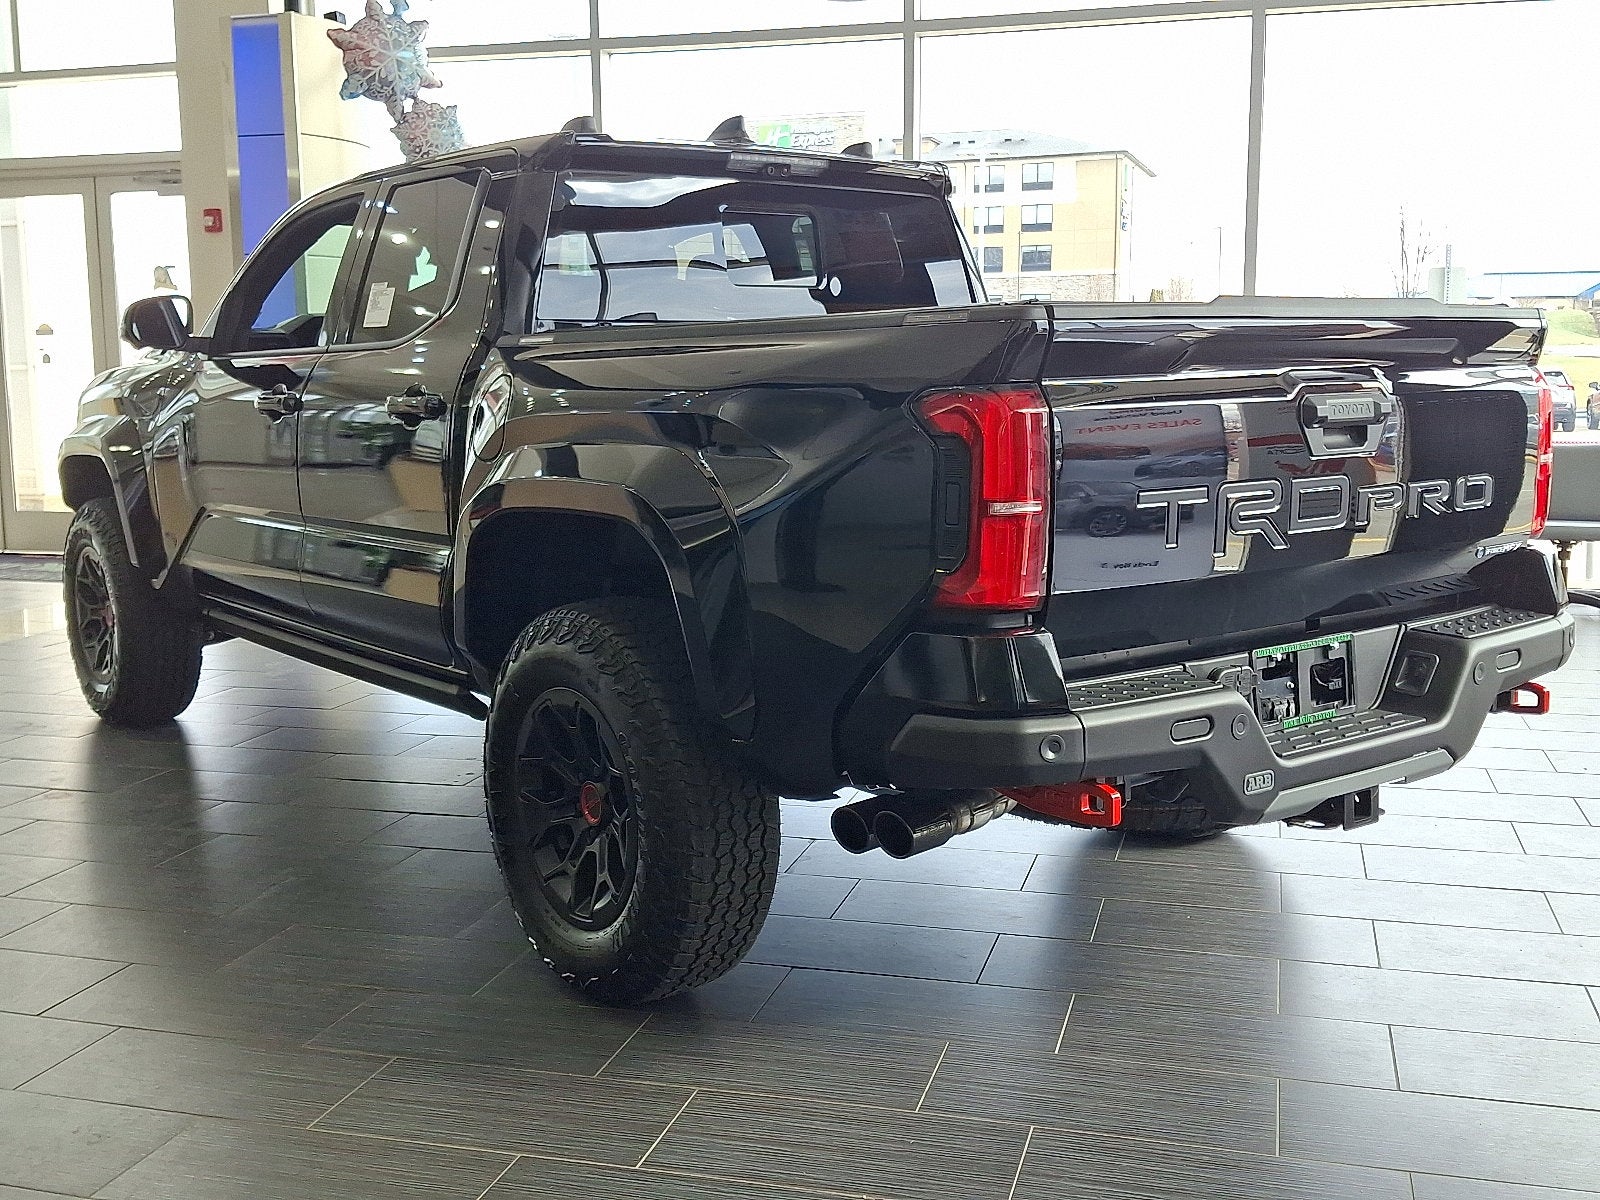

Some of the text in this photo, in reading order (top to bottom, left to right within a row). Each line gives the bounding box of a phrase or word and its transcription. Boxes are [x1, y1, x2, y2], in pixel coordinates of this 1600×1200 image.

[1331, 403, 1372, 416] TOYOTA
[1136, 474, 1494, 559] TRD PRO
[1246, 774, 1272, 791] ARB
